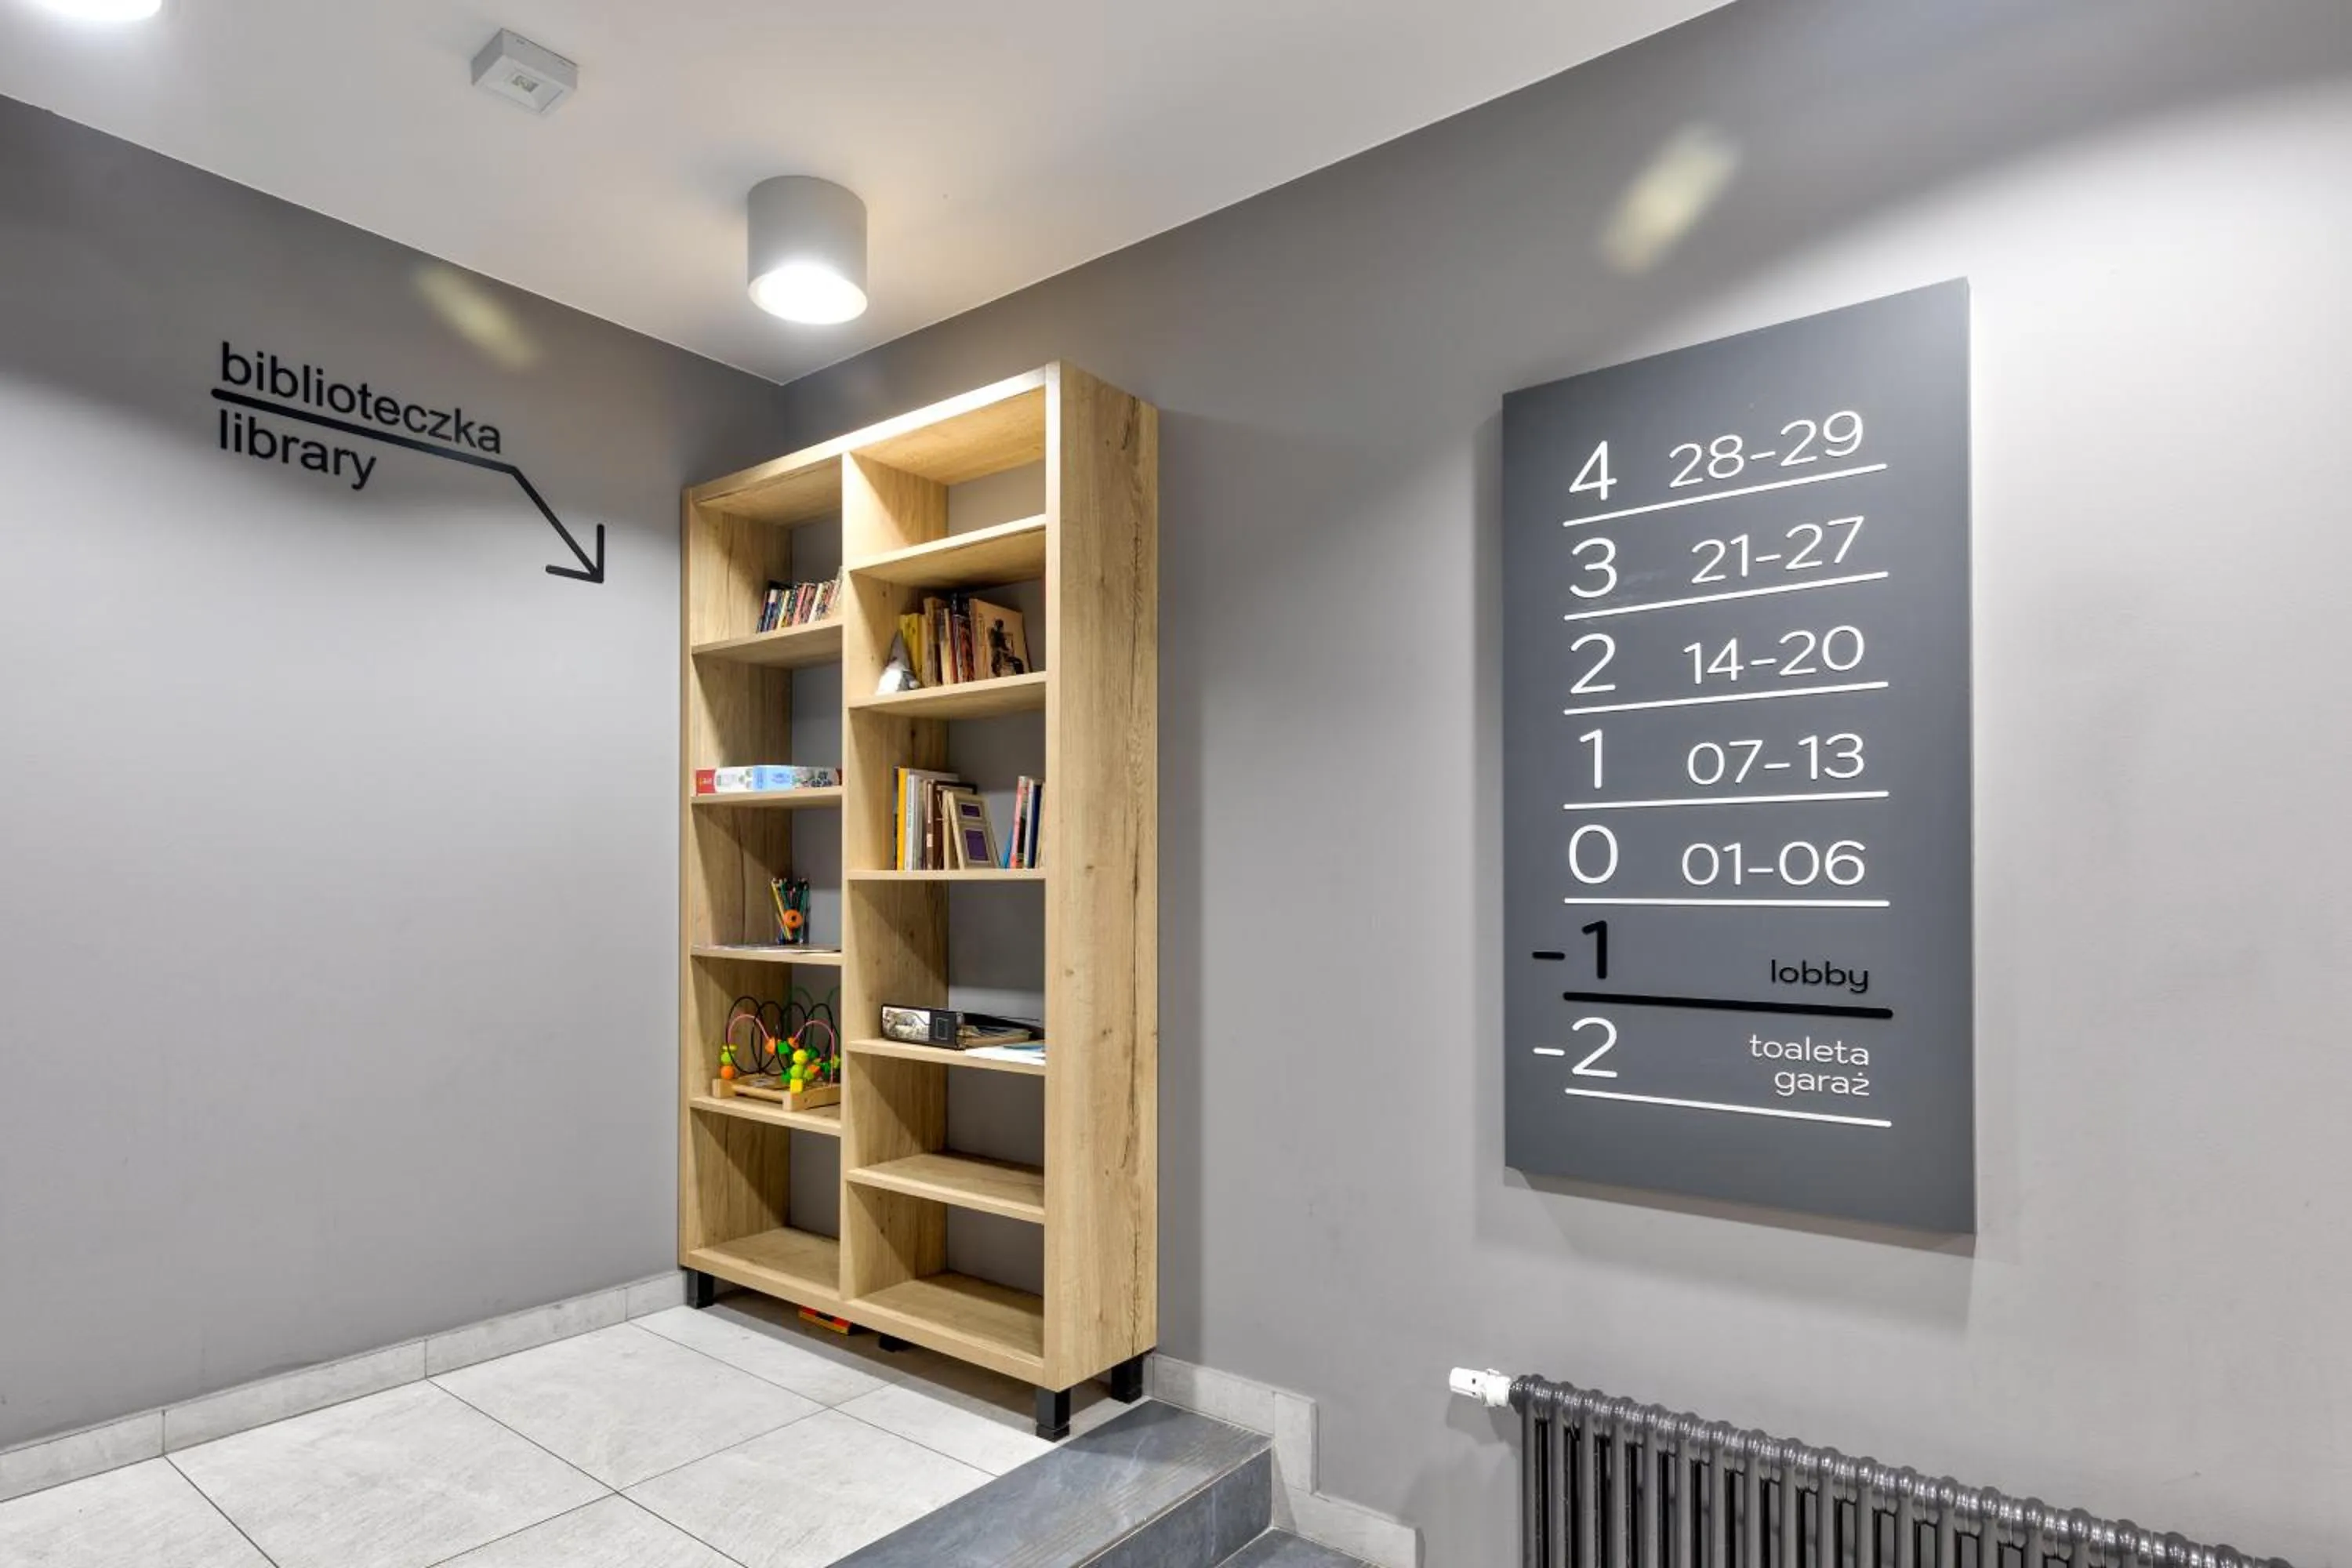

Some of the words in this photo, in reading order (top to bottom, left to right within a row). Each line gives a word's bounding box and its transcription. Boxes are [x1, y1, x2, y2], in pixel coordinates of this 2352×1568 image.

[220, 341, 501, 453] biblioteczka
[220, 409, 377, 490] library
[1569, 441, 1617, 500] 4
[1668, 410, 1864, 488] 28-29
[1570, 537, 1617, 598] 3
[1691, 514, 1865, 583] 21-27
[1570, 633, 1616, 694] 2
[1683, 625, 1865, 684] 14-20
[1579, 728, 1603, 789] 1
[1687, 732, 1865, 785] 07-13
[1568, 824, 1619, 884] 0
[1682, 840, 1866, 886] 01-06
[1531, 920, 1608, 980] -1
[1771, 959, 1868, 994] lobby
[1533, 1017, 1618, 1078] -2
[1749, 1034, 1869, 1065] toaleta
[1774, 1071, 1870, 1097] garaż
